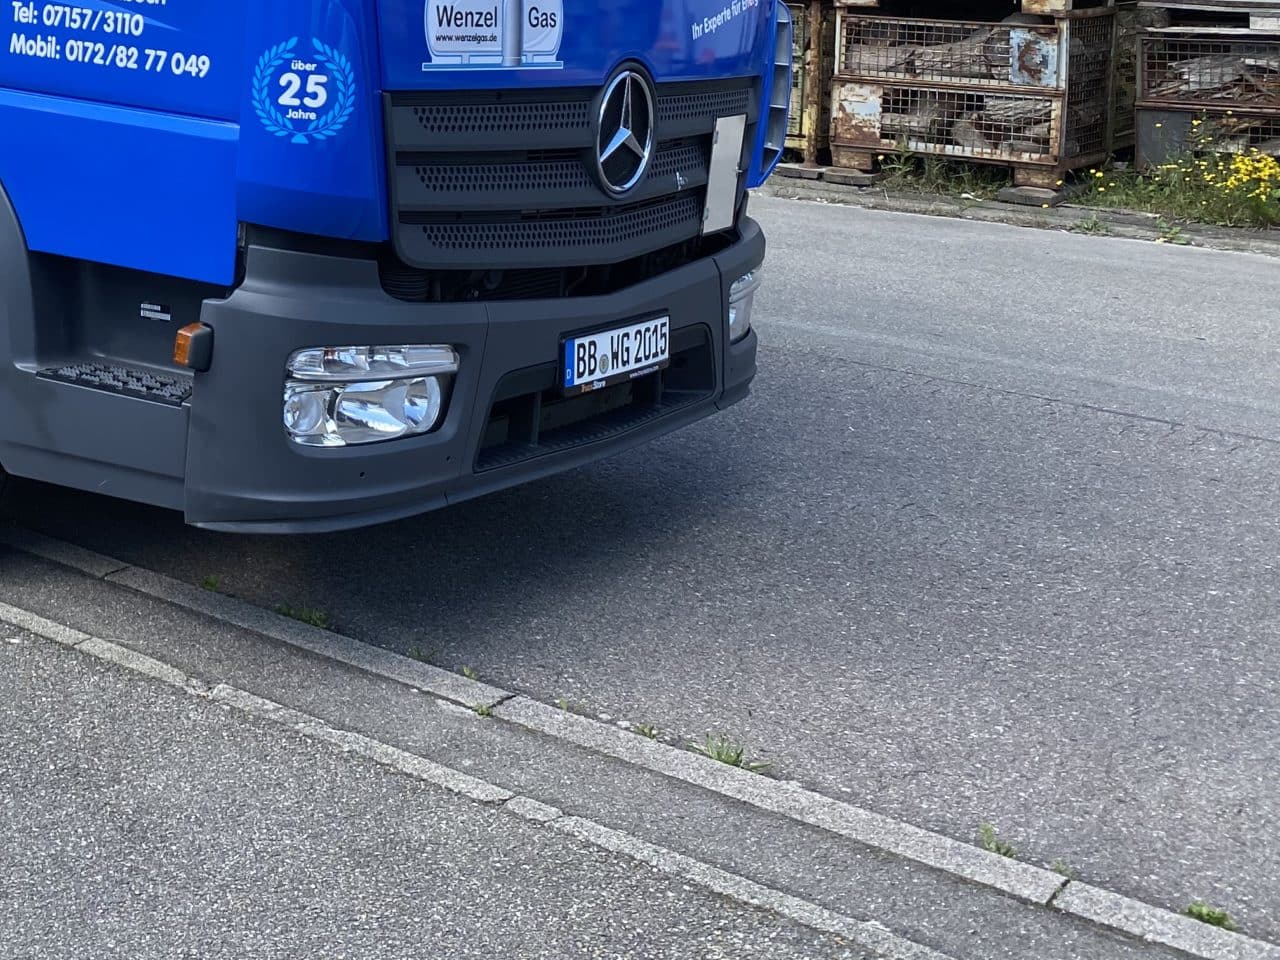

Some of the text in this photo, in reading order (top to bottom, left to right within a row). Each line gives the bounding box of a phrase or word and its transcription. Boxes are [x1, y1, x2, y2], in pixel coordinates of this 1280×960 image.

[11, 1, 38, 25] Tel:
[42, 4, 144, 37] 07157/3110
[436, 5, 497, 28] Wenzel
[528, 6, 557, 28] Gas
[691, 22, 703, 40] Ihr
[703, 7, 731, 33] Experte
[731, 0, 741, 17] für
[435, 33, 497, 44] www.wenzelgas.de
[9, 32, 211, 79] Mobil: 0172/82 77 049
[291, 59, 317, 71] über
[278, 72, 328, 108] 25
[286, 108, 317, 120] Jahre
[576, 322, 667, 379] BB WG 2015
[566, 368, 571, 379] D
